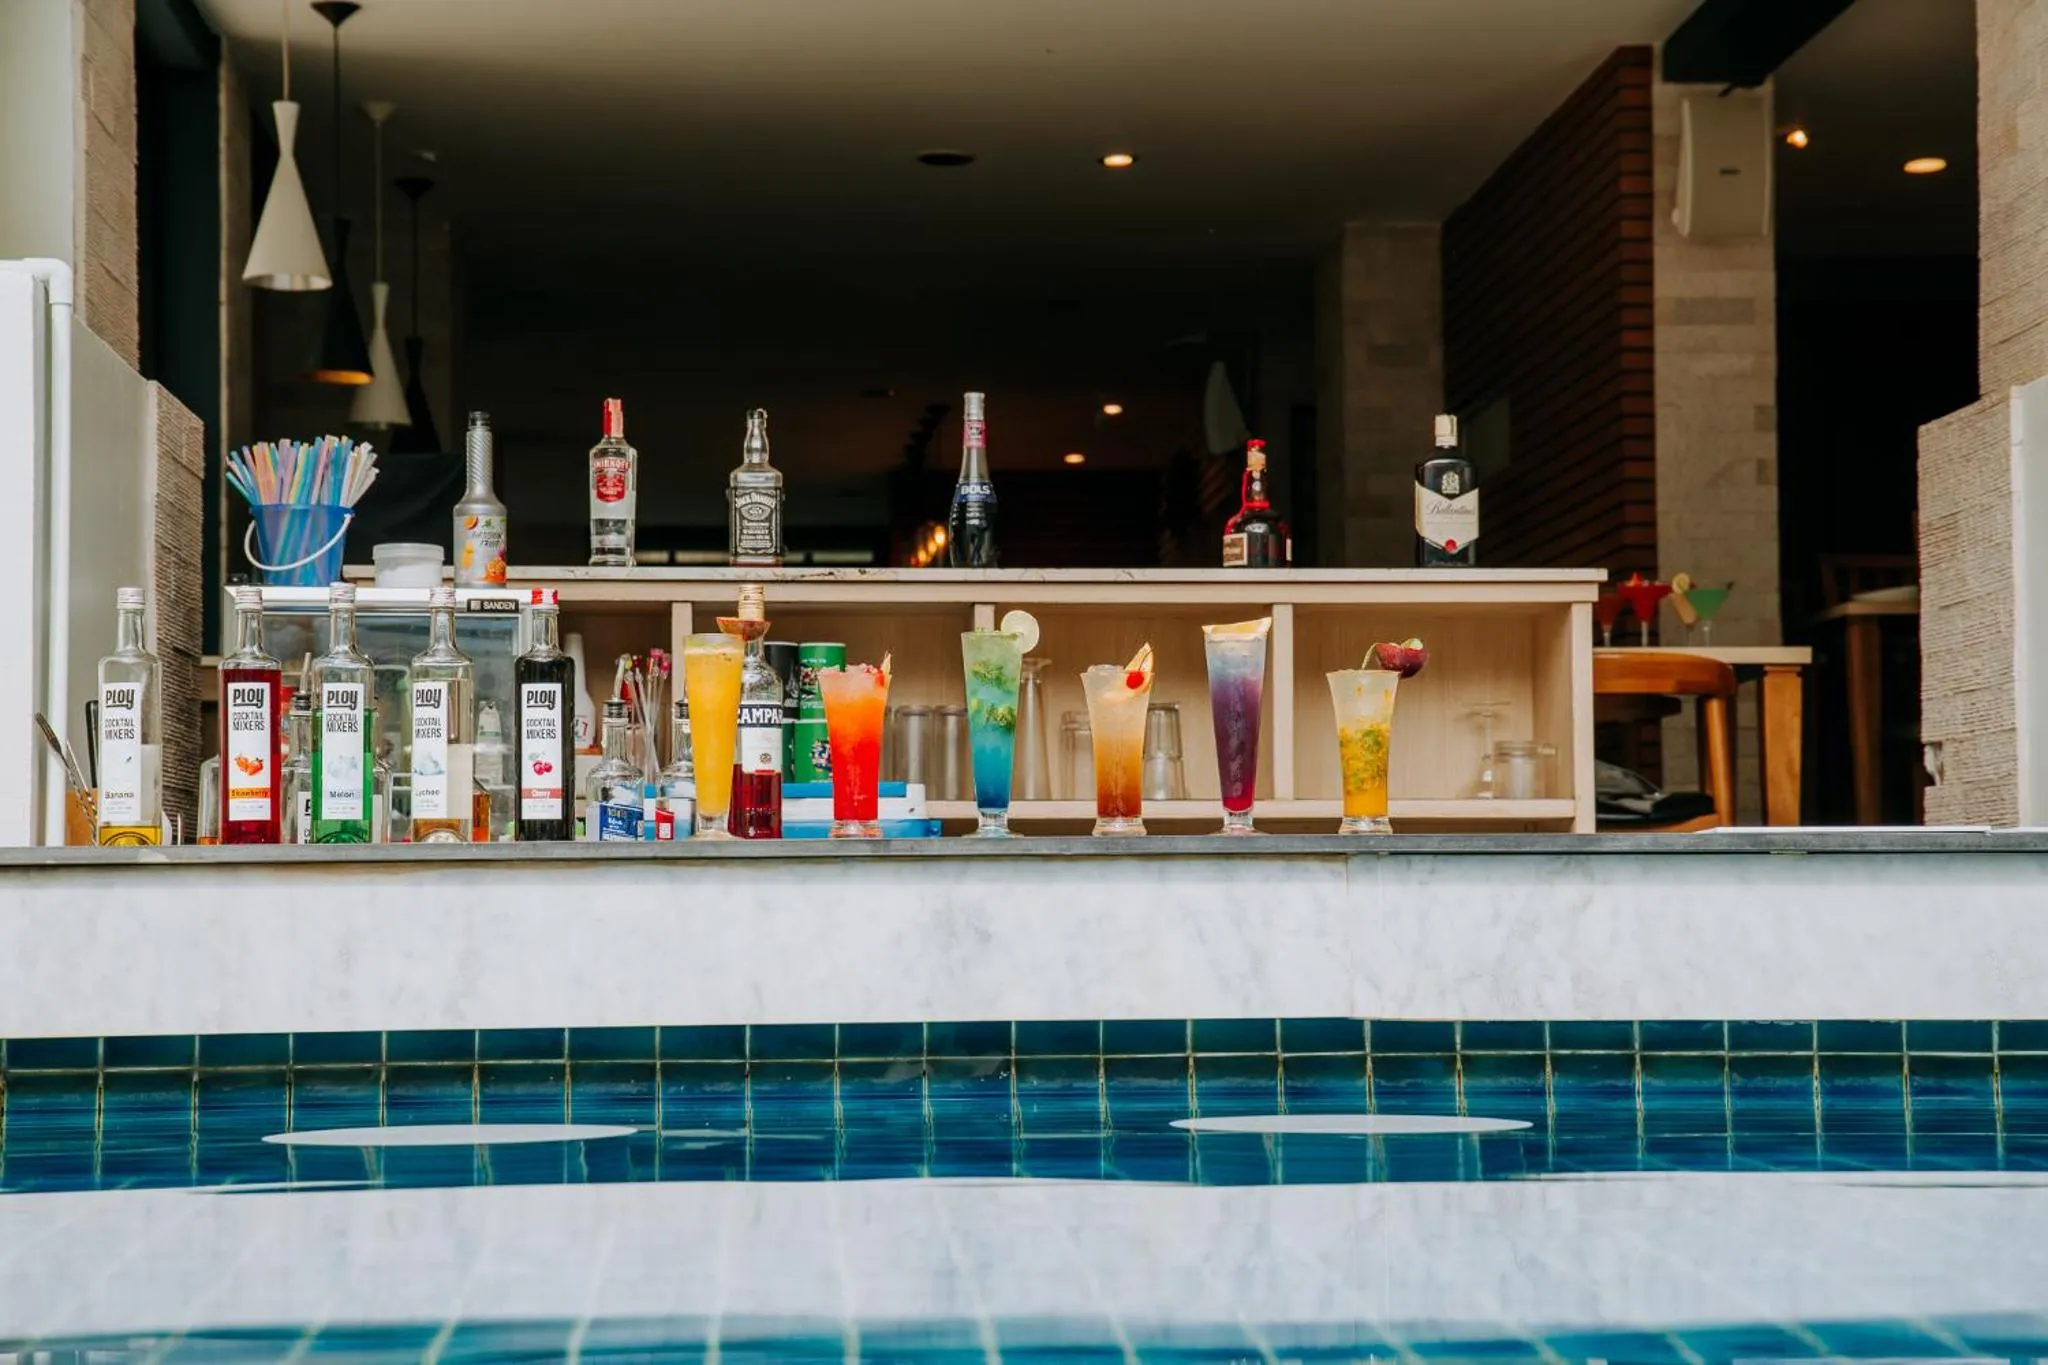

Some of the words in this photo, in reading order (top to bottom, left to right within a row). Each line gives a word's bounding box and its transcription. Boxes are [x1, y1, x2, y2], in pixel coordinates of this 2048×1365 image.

[960, 484, 991, 494] BOLS
[483, 601, 516, 611] SANDEN
[232, 711, 265, 722] COCKTAIL
[326, 713, 358, 723] COCKTAIL
[104, 718, 135, 728] COCKTAIL
[232, 720, 265, 731] MIXERS
[327, 721, 358, 733] MIXERS
[415, 717, 442, 728] COCKTAIL
[526, 717, 556, 728] COCKTAIL
[104, 729, 135, 740] MIXERS
[415, 728, 442, 739] MIXERS
[526, 728, 557, 740] MIXERS
